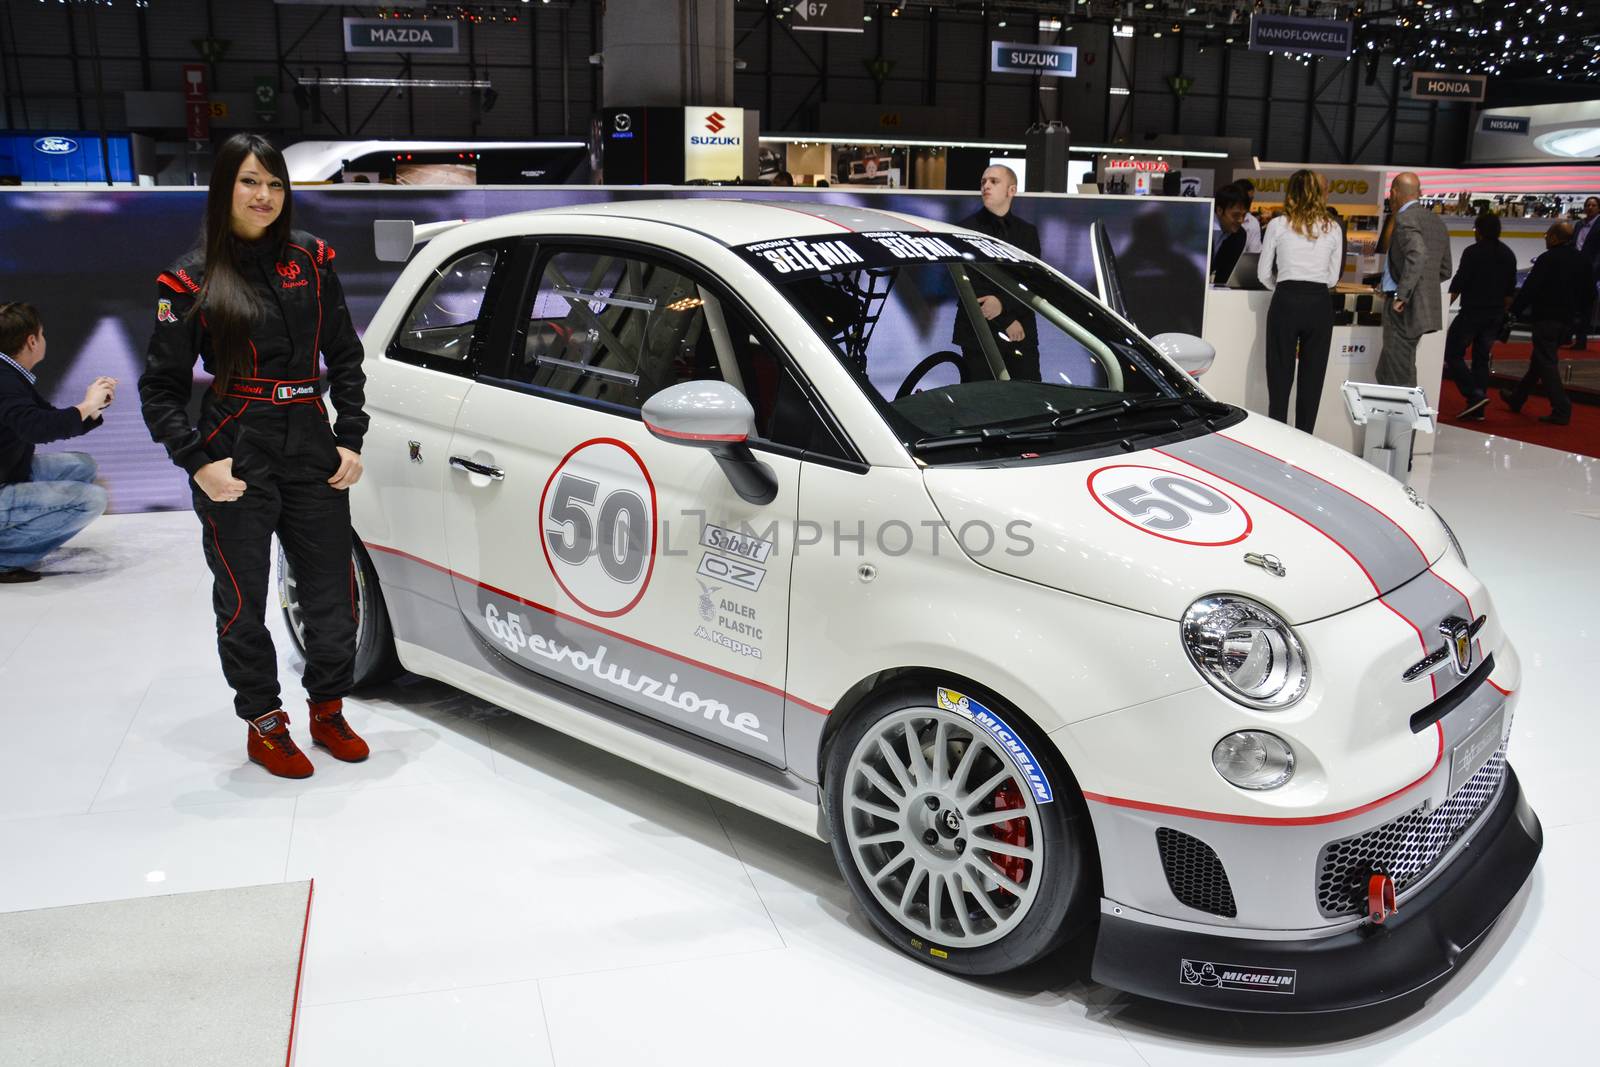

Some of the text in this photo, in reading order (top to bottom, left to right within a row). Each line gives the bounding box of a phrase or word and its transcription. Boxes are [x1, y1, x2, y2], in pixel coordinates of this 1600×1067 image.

[808, 2, 828, 17] 67
[370, 28, 433, 42] MAZDA
[1257, 27, 1345, 44] NANOFLOWCELL
[1011, 52, 1059, 67] SUZUKI
[1427, 81, 1471, 94] HONDA
[1490, 119, 1520, 131] NISSAN
[42, 139, 70, 151] Ford
[690, 135, 740, 145] SUZUKI
[1111, 159, 1169, 173] HONDA
[1102, 476, 1232, 531] 50
[546, 472, 649, 584] 50
[708, 528, 763, 559] Sabelt
[719, 599, 756, 620] ADLER
[718, 615, 763, 640] PLASTIC
[711, 630, 763, 660] Kappa
[528, 632, 769, 742] evoluzione
[976, 711, 1050, 800] MICHELIN
[1221, 971, 1293, 985] MICHELIN
